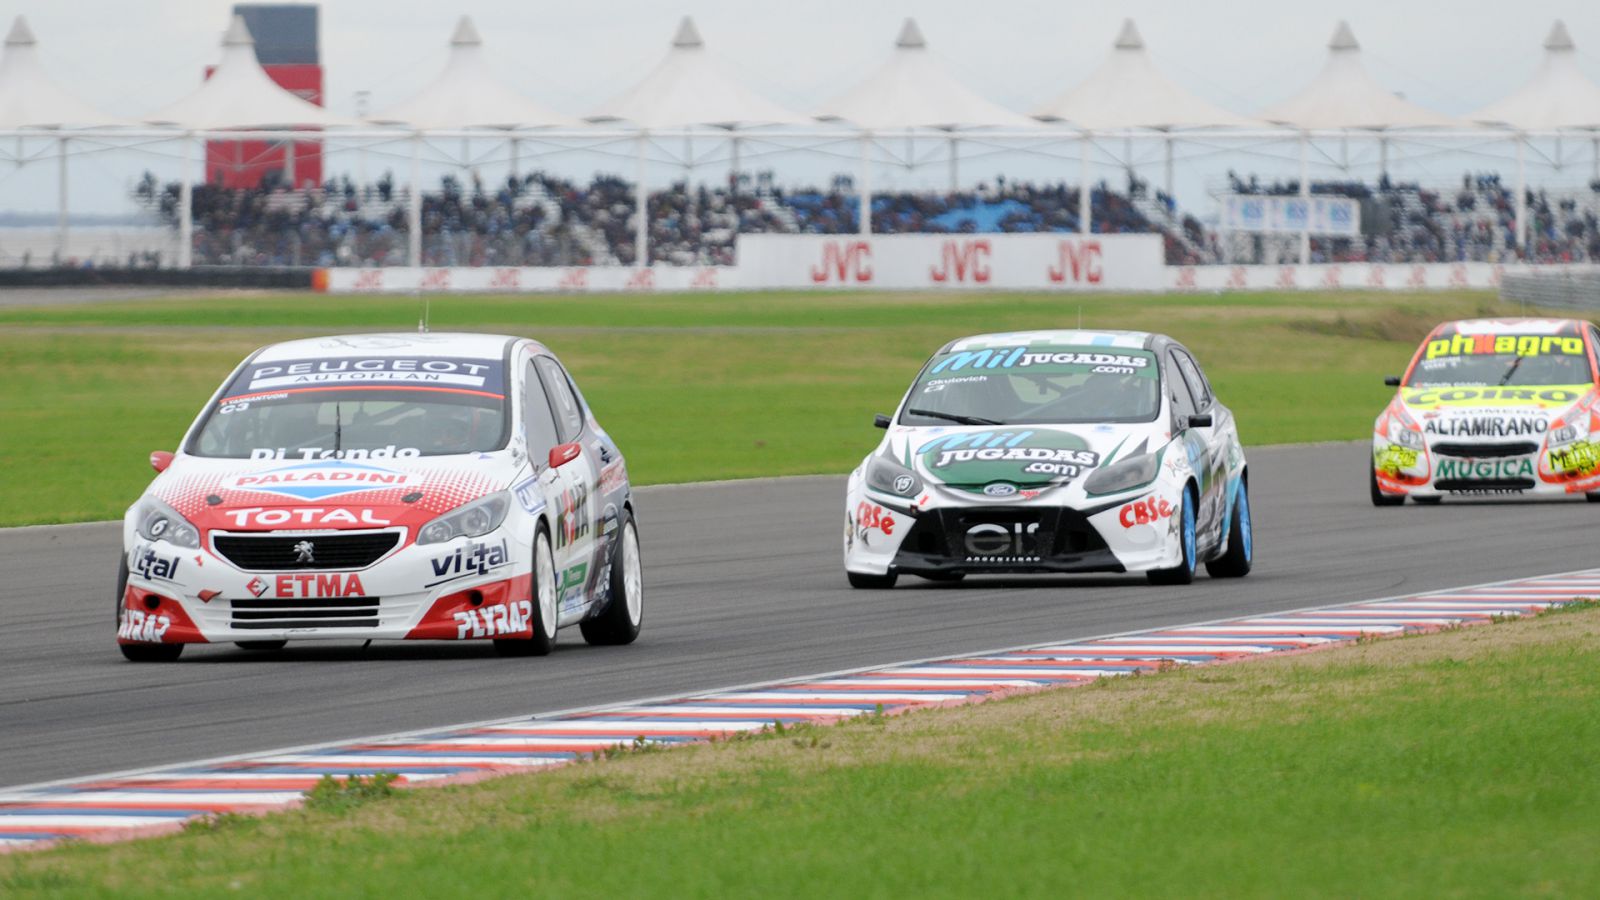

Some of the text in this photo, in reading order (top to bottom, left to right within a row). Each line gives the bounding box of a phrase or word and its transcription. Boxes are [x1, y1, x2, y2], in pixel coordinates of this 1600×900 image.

[811, 241, 874, 283] JVC
[929, 240, 991, 283] JVC
[1048, 241, 1104, 283] JVC
[253, 360, 489, 379] PEUGEOT
[930, 347, 1147, 374] Mil JUGADAS
[1091, 365, 1134, 374] .com
[295, 372, 440, 382] AUTOPLAN
[1407, 389, 1579, 404] COIRO
[220, 402, 250, 414] C3
[1425, 417, 1548, 436] ALTAMIRANO
[916, 430, 1033, 455] Mil
[935, 447, 1096, 466] JUGADAS
[1024, 461, 1077, 476] .com
[1436, 460, 1533, 478] MUGICA
[236, 472, 407, 486] PALADINI
[895, 477, 911, 490] 15
[225, 508, 390, 526] TOTAL
[151, 520, 168, 535] 6
[276, 574, 365, 597] ETMA
[453, 600, 532, 639] PLYRAP
